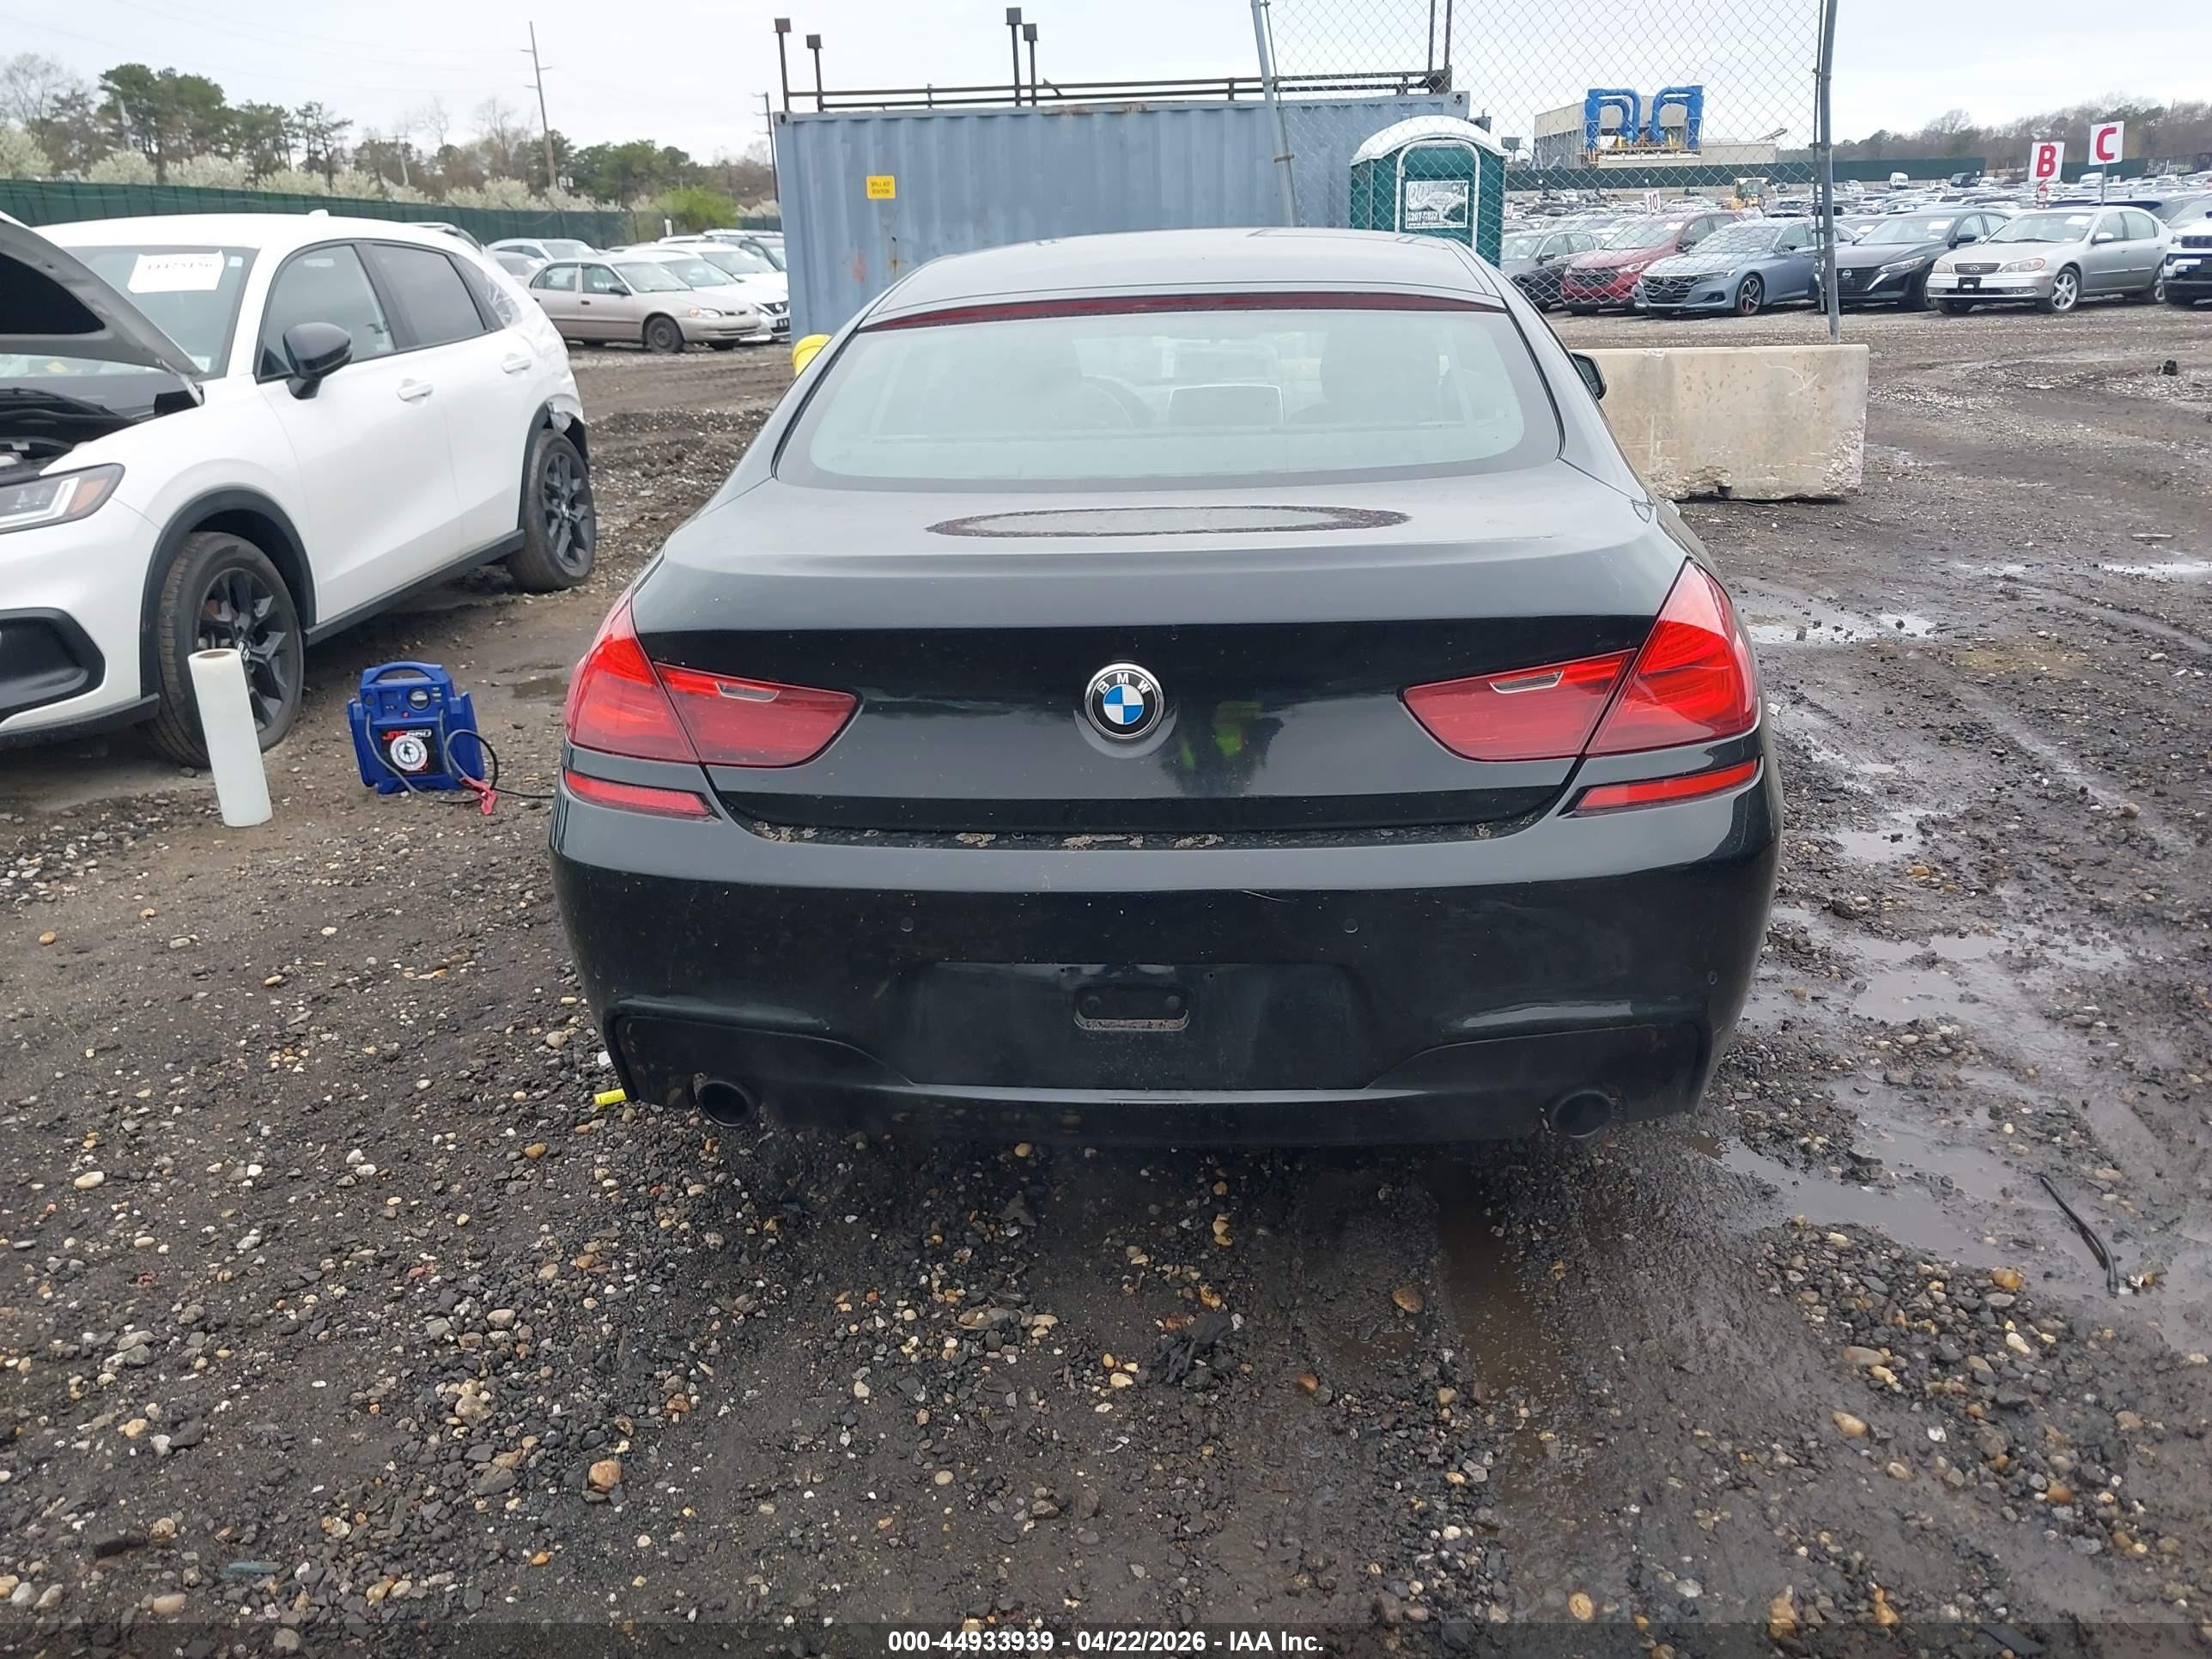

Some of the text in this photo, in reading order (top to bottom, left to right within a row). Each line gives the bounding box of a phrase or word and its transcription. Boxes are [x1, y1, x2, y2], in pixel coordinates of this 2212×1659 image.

[2096, 127, 2117, 161] C
[2036, 145, 2057, 177] B
[1649, 194, 1657, 211] 10
[1097, 672, 1152, 695] BMW
